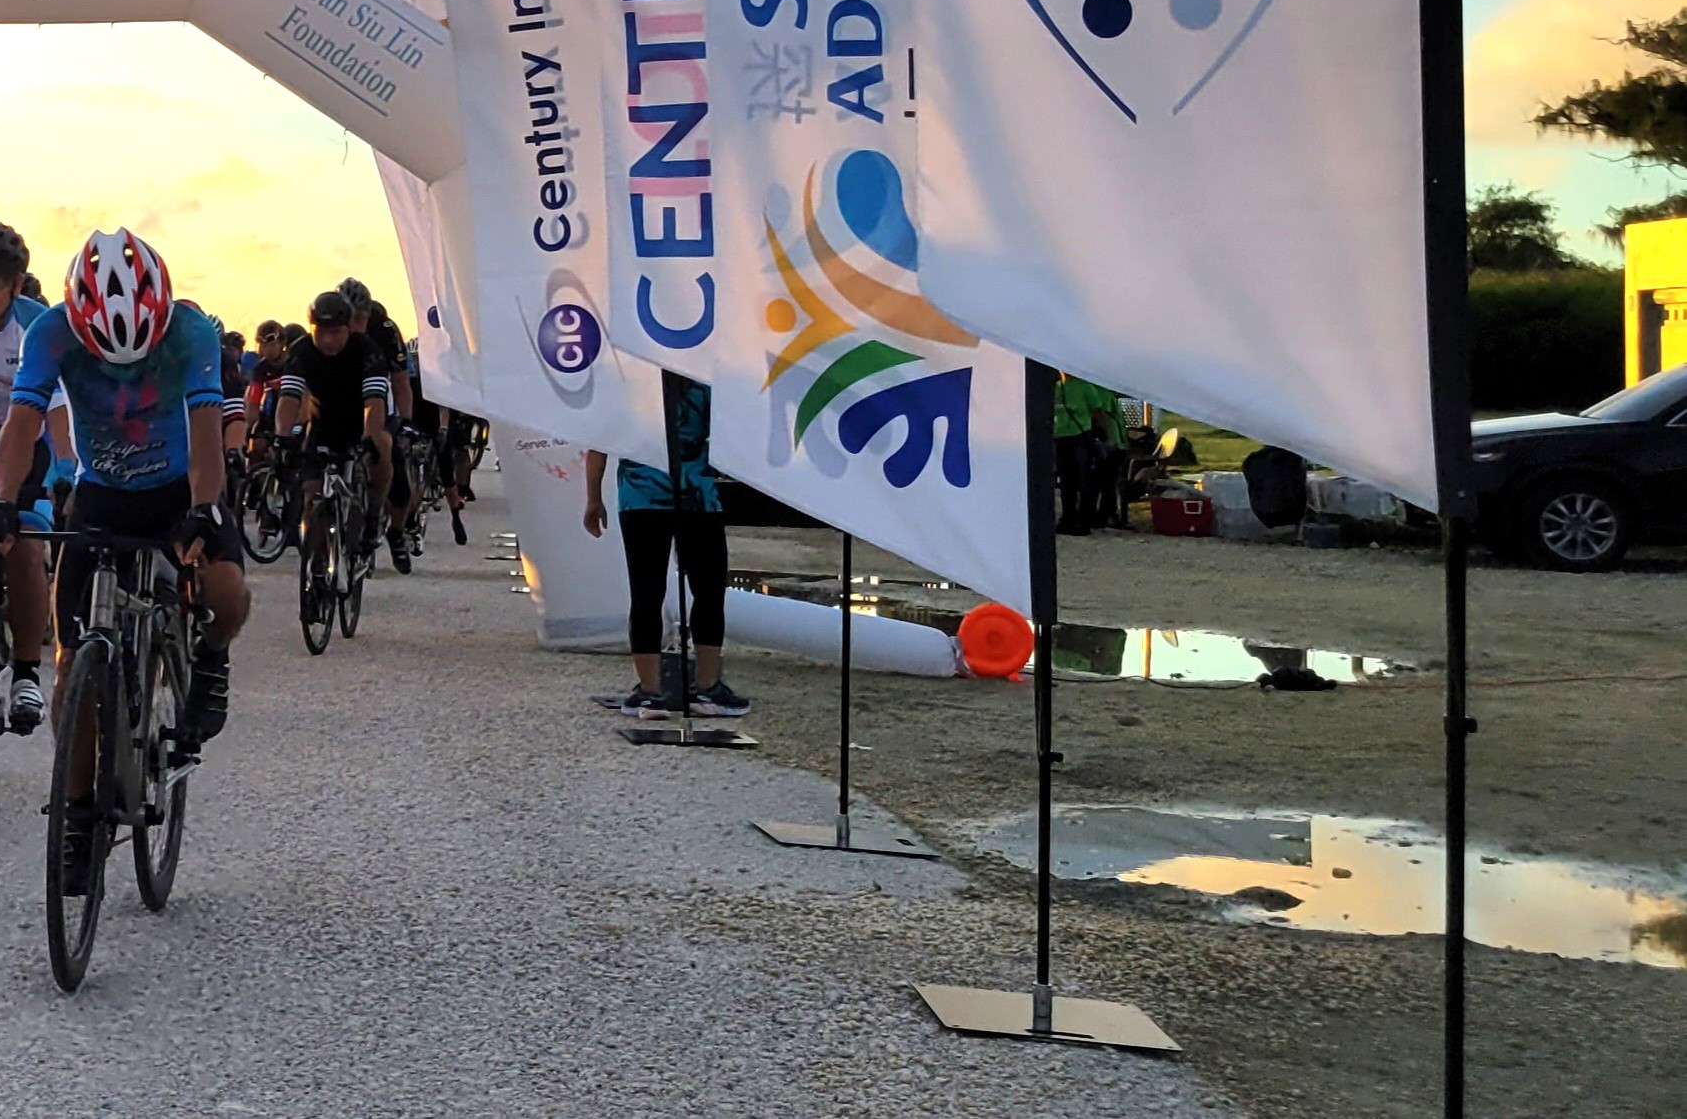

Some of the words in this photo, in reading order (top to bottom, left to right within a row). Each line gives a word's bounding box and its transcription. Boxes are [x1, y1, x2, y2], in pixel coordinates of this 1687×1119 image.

[279, 4, 398, 104] Foundation
[347, 0, 383, 43] Siu
[384, 26, 425, 70] Lin
[516, 49, 571, 253] Century
[552, 307, 584, 370] CIC
